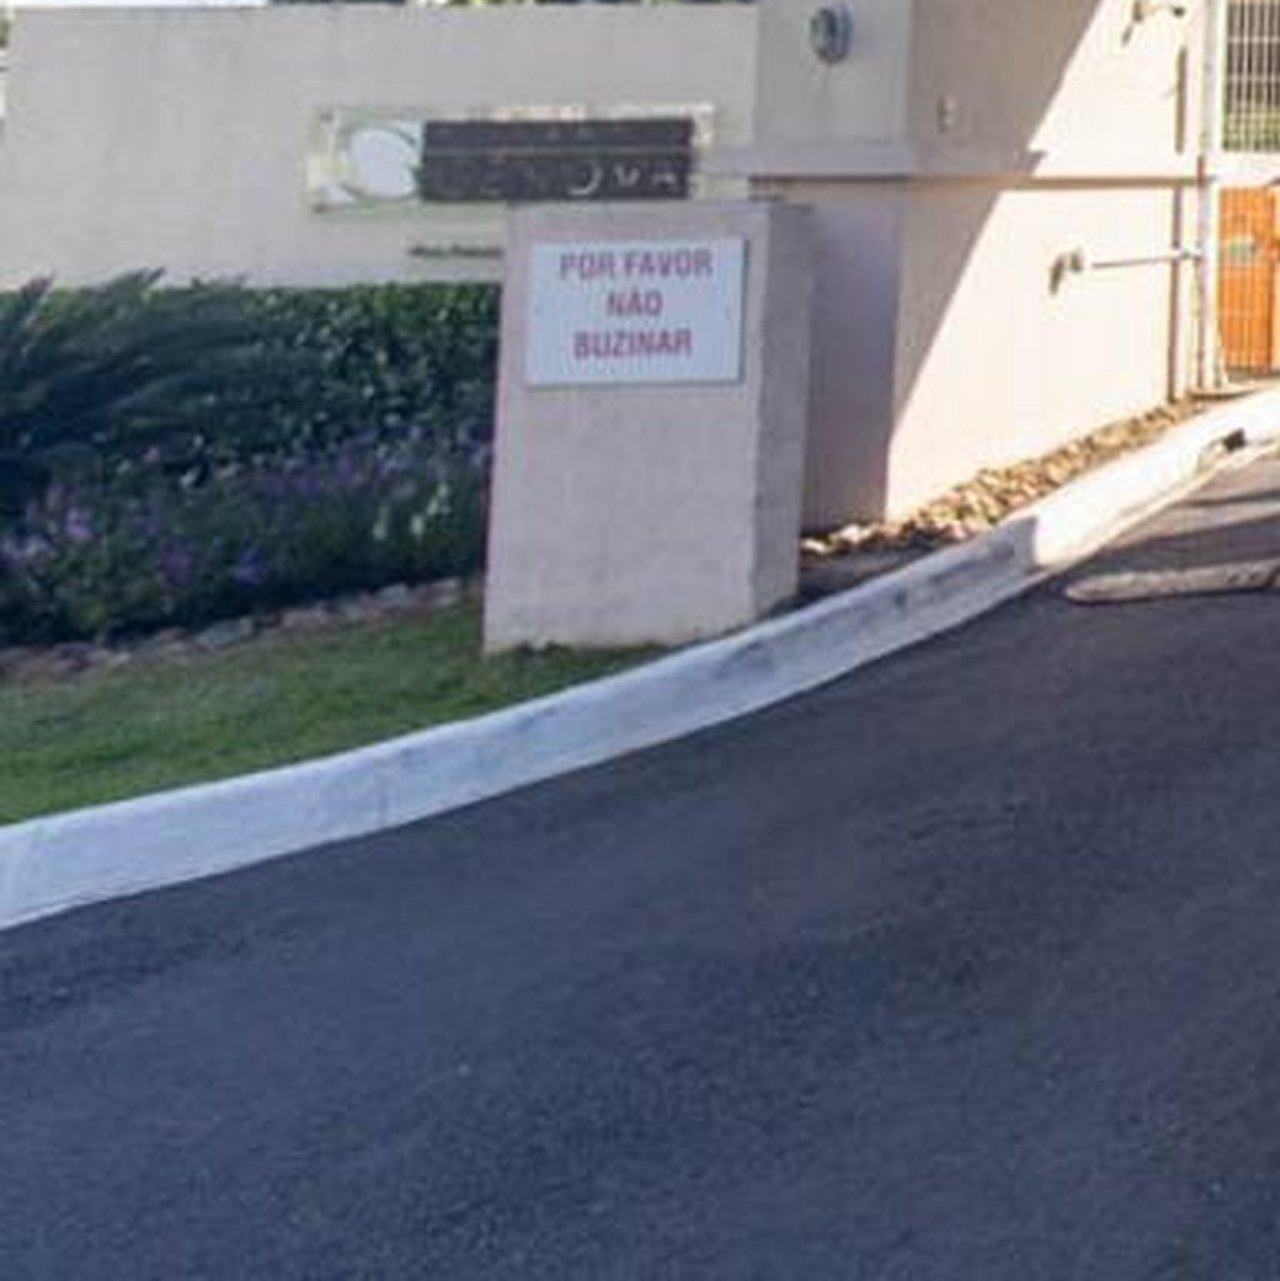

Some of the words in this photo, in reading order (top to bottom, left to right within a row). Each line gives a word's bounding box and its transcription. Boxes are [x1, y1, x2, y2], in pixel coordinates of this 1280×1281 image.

[559, 251, 616, 281] POR
[623, 248, 714, 279] FAVOR
[606, 285, 664, 318] NÃO
[572, 328, 693, 360] BUZINAR
